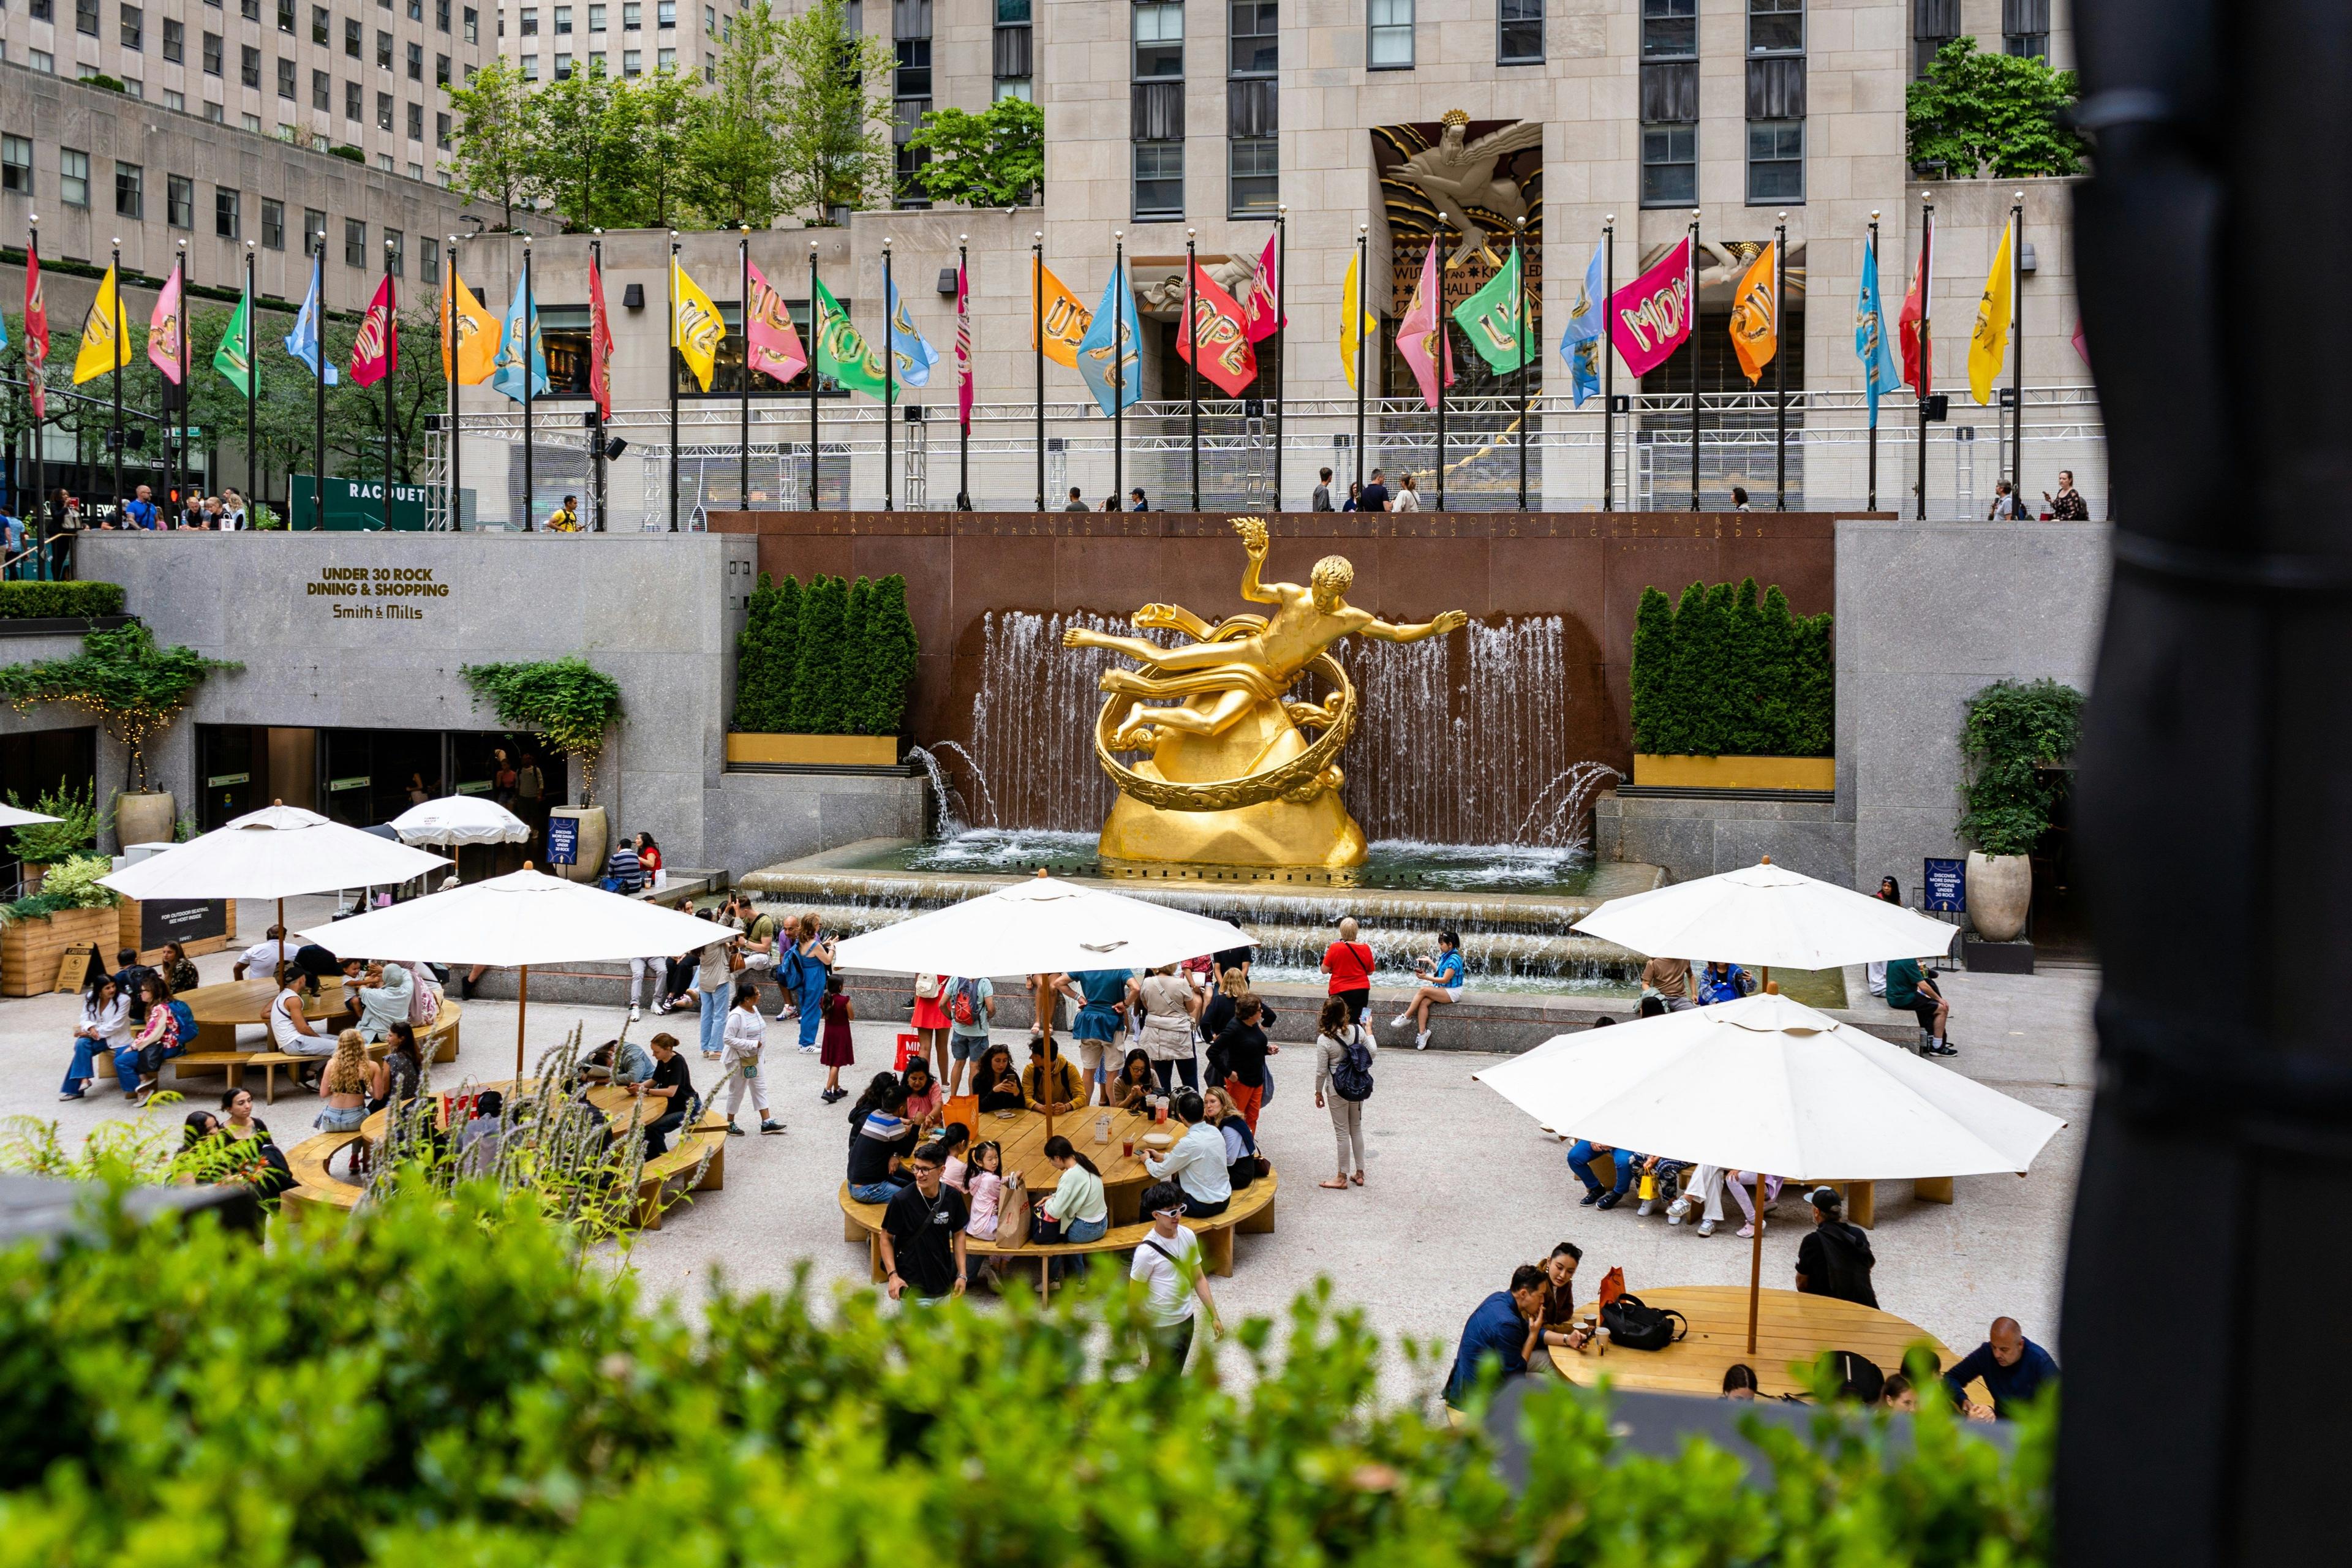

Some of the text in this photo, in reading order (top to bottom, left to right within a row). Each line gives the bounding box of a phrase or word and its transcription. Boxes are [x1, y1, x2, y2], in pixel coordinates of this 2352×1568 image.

[1444, 282, 1472, 295] HALL
[350, 483, 425, 502] RACUET
[1695, 529, 1762, 537] ENDS
[322, 568, 433, 581] UNDER 30 ROCK
[307, 582, 449, 597] DINING & SHOPPING
[333, 604, 423, 619] Smith & Mills
